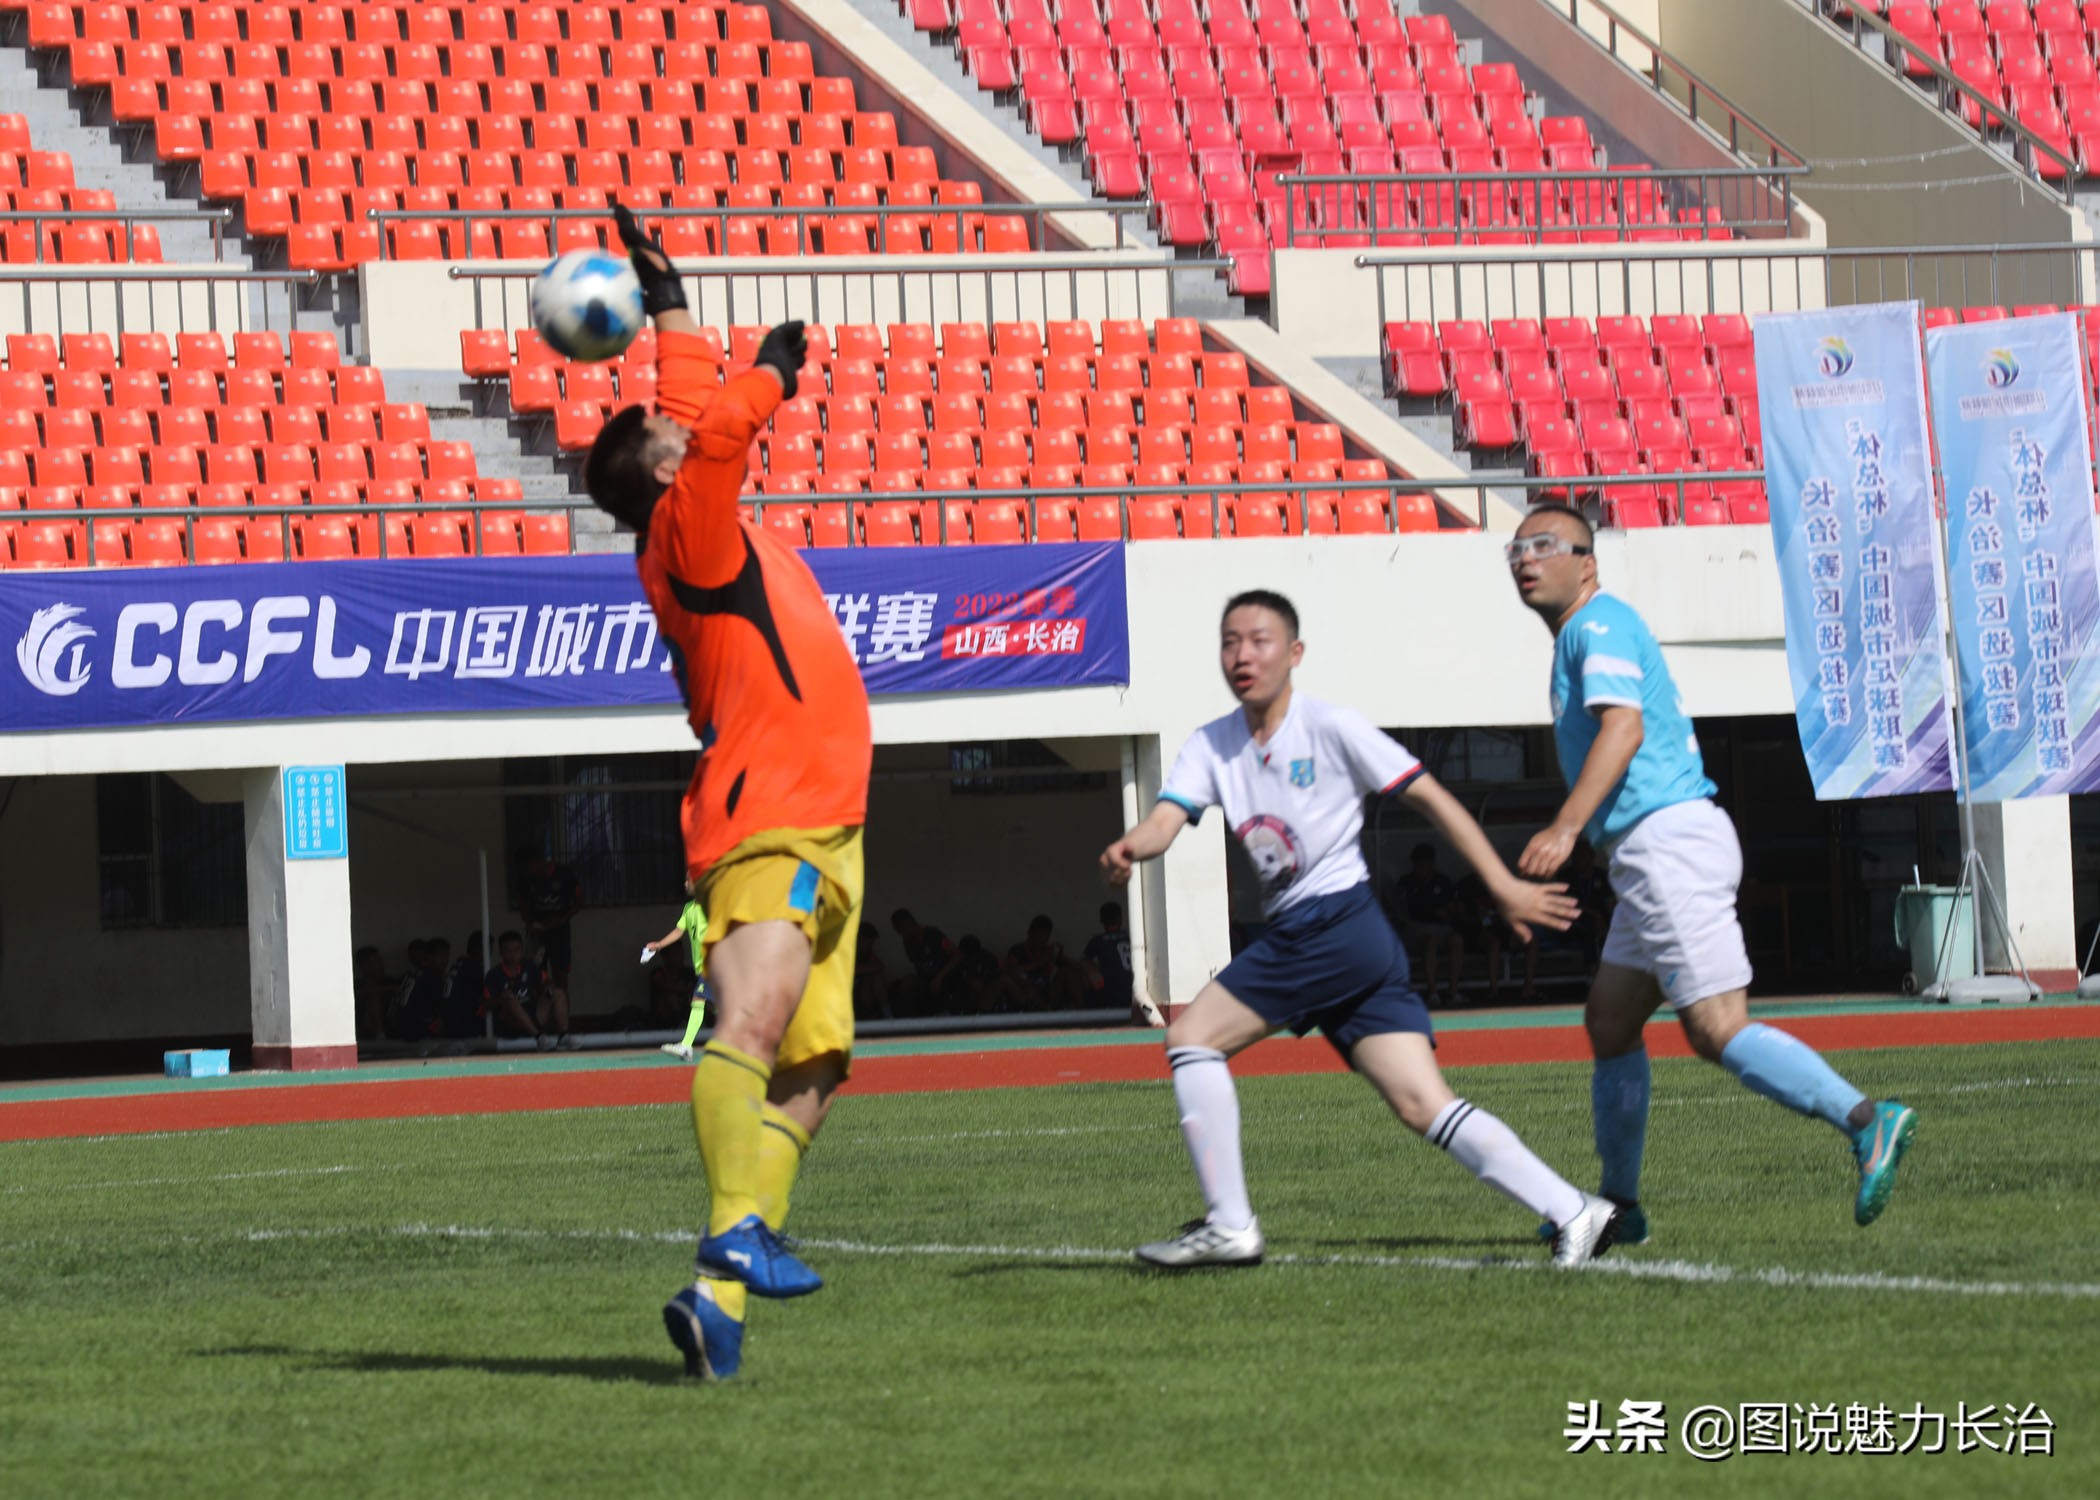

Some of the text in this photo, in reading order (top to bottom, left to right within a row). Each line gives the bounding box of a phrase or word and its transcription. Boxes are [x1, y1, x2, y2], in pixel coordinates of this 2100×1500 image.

[111, 590, 939, 689] CCFL 中国城市联赛
[954, 621, 1081, 655] 山西·长治
